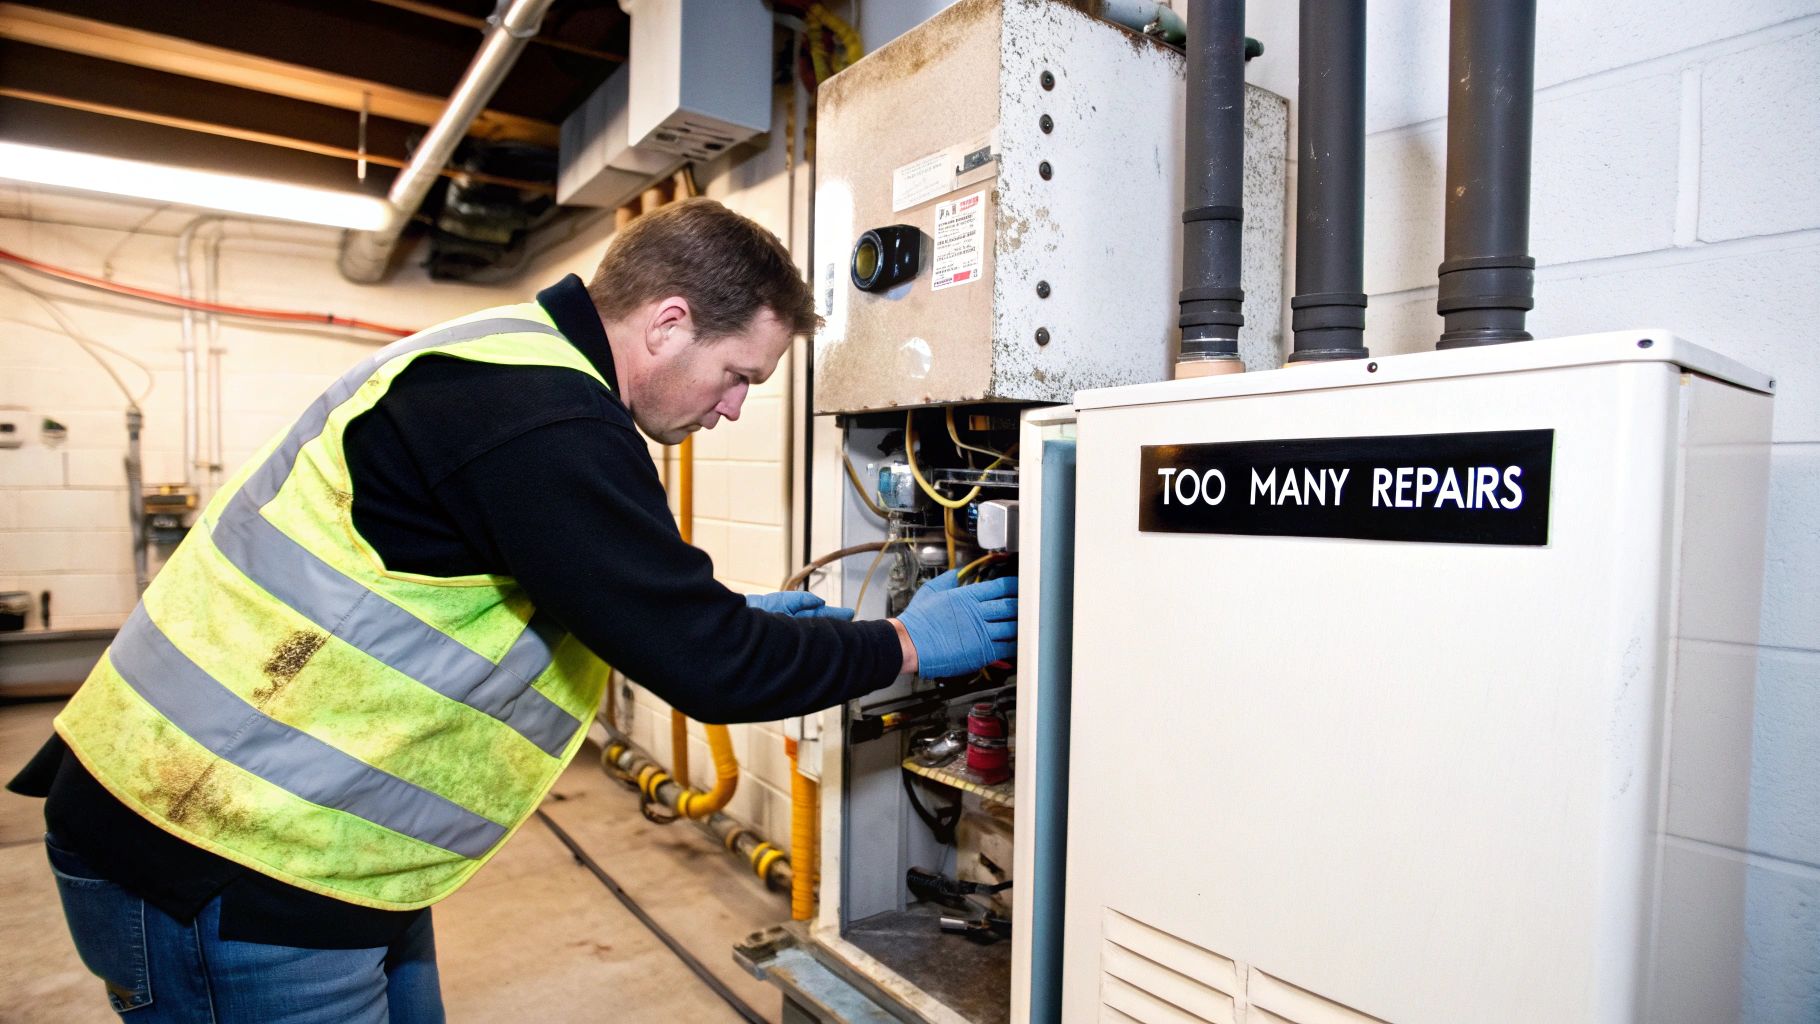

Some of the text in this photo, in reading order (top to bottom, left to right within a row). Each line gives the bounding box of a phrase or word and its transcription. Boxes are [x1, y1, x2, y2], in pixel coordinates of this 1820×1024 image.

[1157, 466, 1523, 510] TOO MANY REPAIRS
